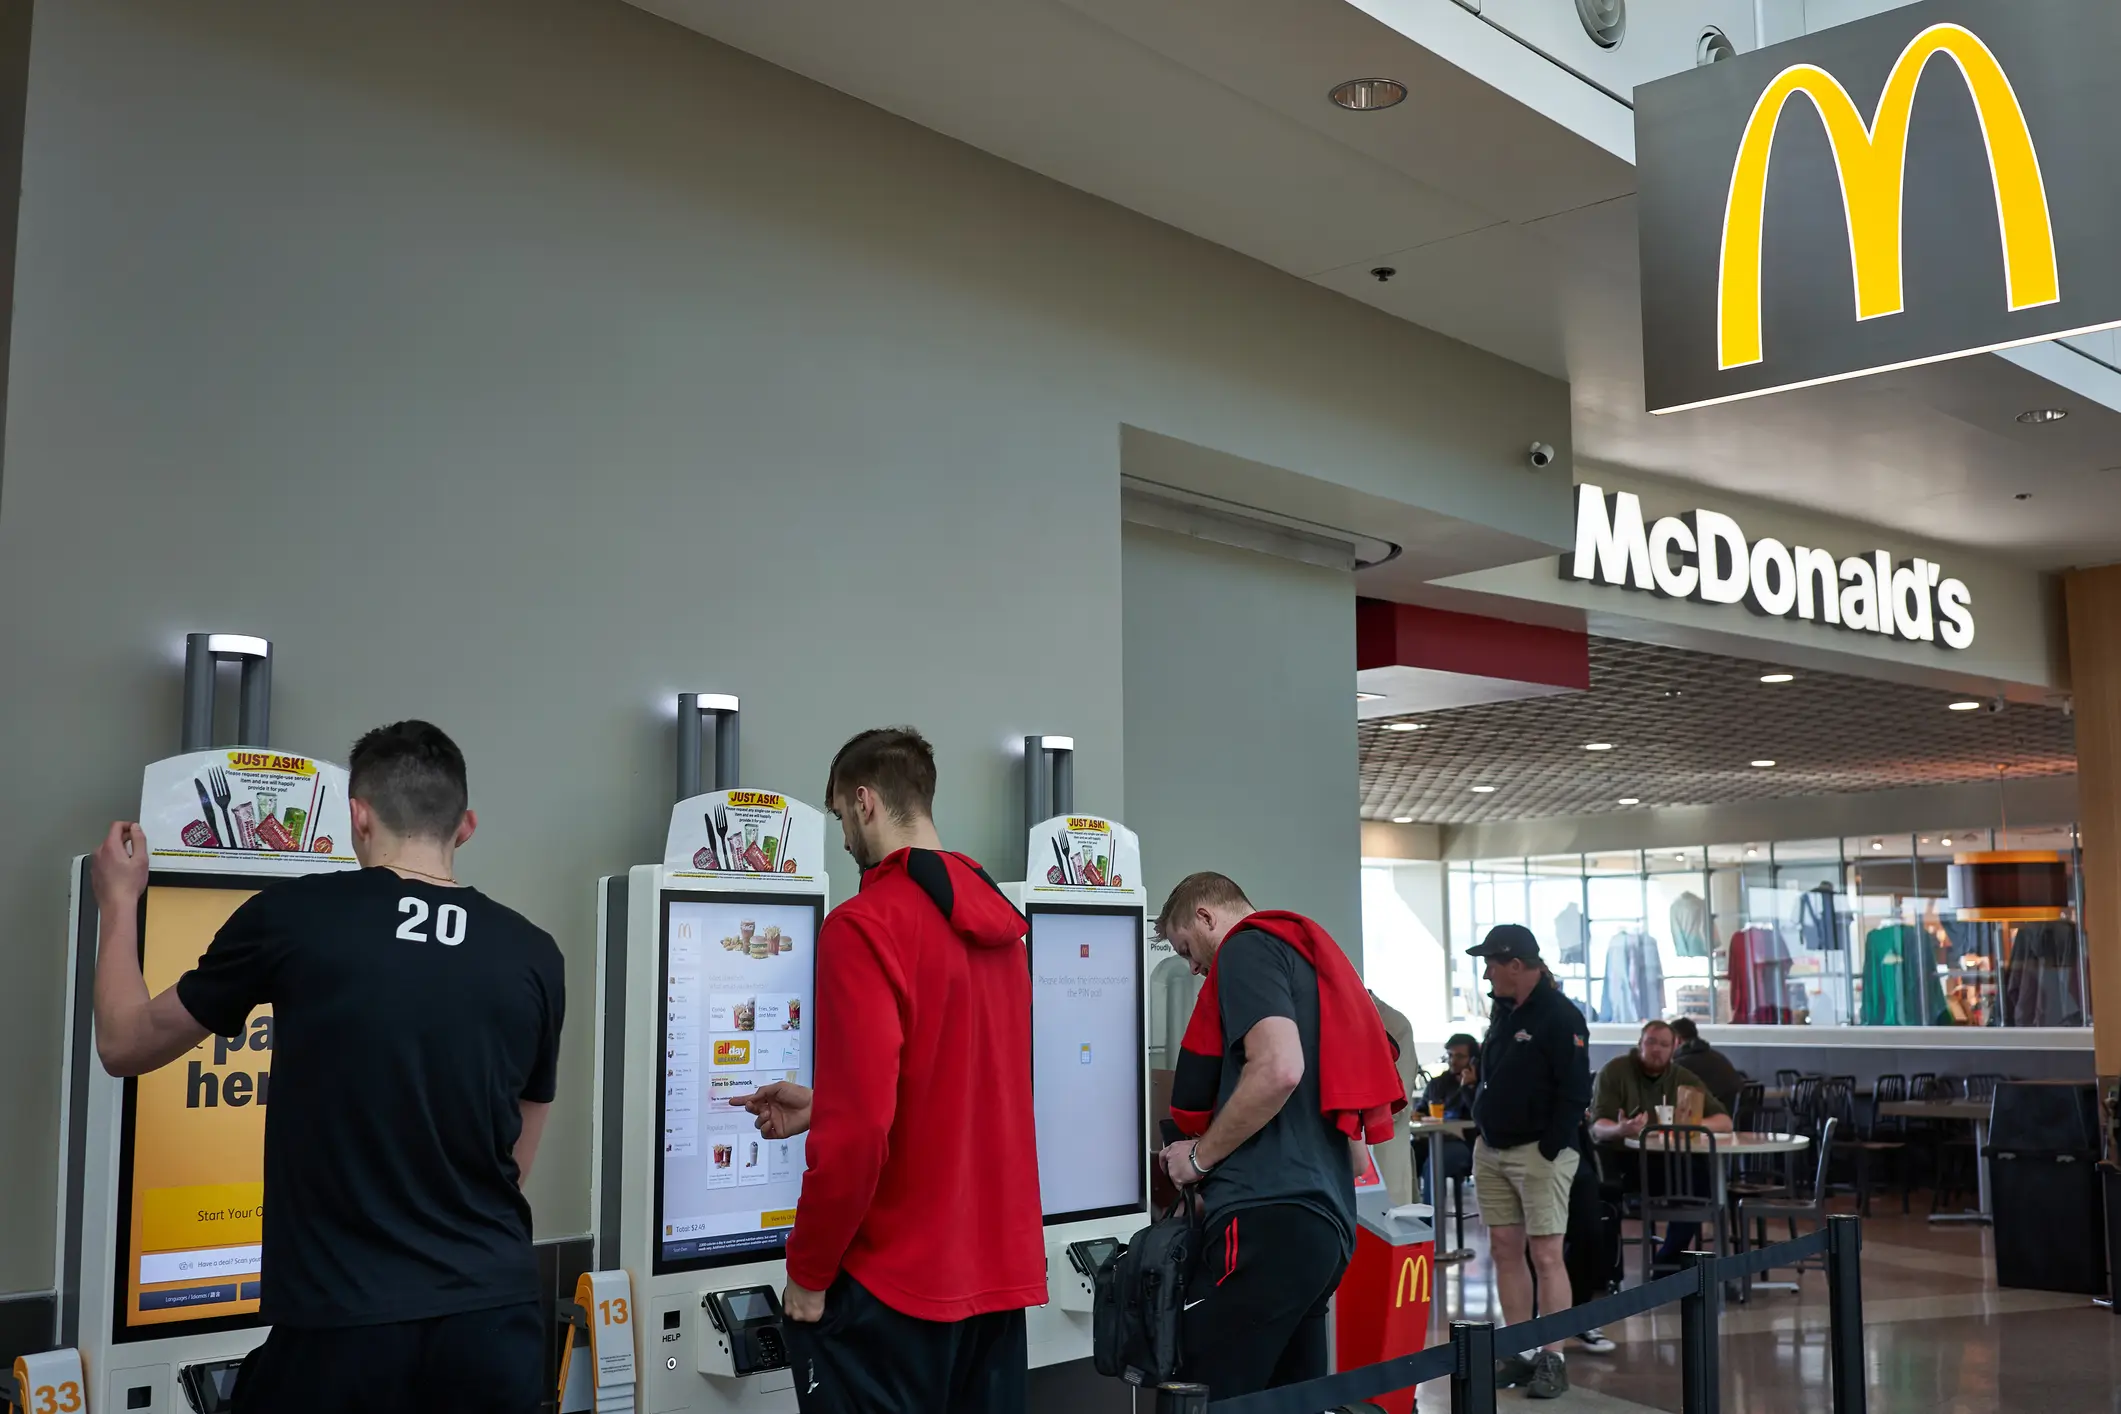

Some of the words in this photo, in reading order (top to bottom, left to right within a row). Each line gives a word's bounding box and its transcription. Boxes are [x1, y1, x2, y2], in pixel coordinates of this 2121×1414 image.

[1573, 482, 1975, 650] McDonald's
[233, 752, 270, 766] JUST
[272, 756, 305, 770] ASK!
[731, 792, 756, 802] JUST
[757, 794, 779, 804] ASK!
[1069, 818, 1087, 827] JUST
[1089, 820, 1105, 828] ASK!
[396, 896, 468, 946] 20
[1151, 944, 1171, 952] Proudly
[1067, 988, 1077, 997] the
[197, 1210, 224, 1222] Start
[227, 1208, 253, 1220] Your
[599, 1298, 628, 1326] 13
[662, 1333, 681, 1342] HELP
[35, 1381, 82, 1414] 33
